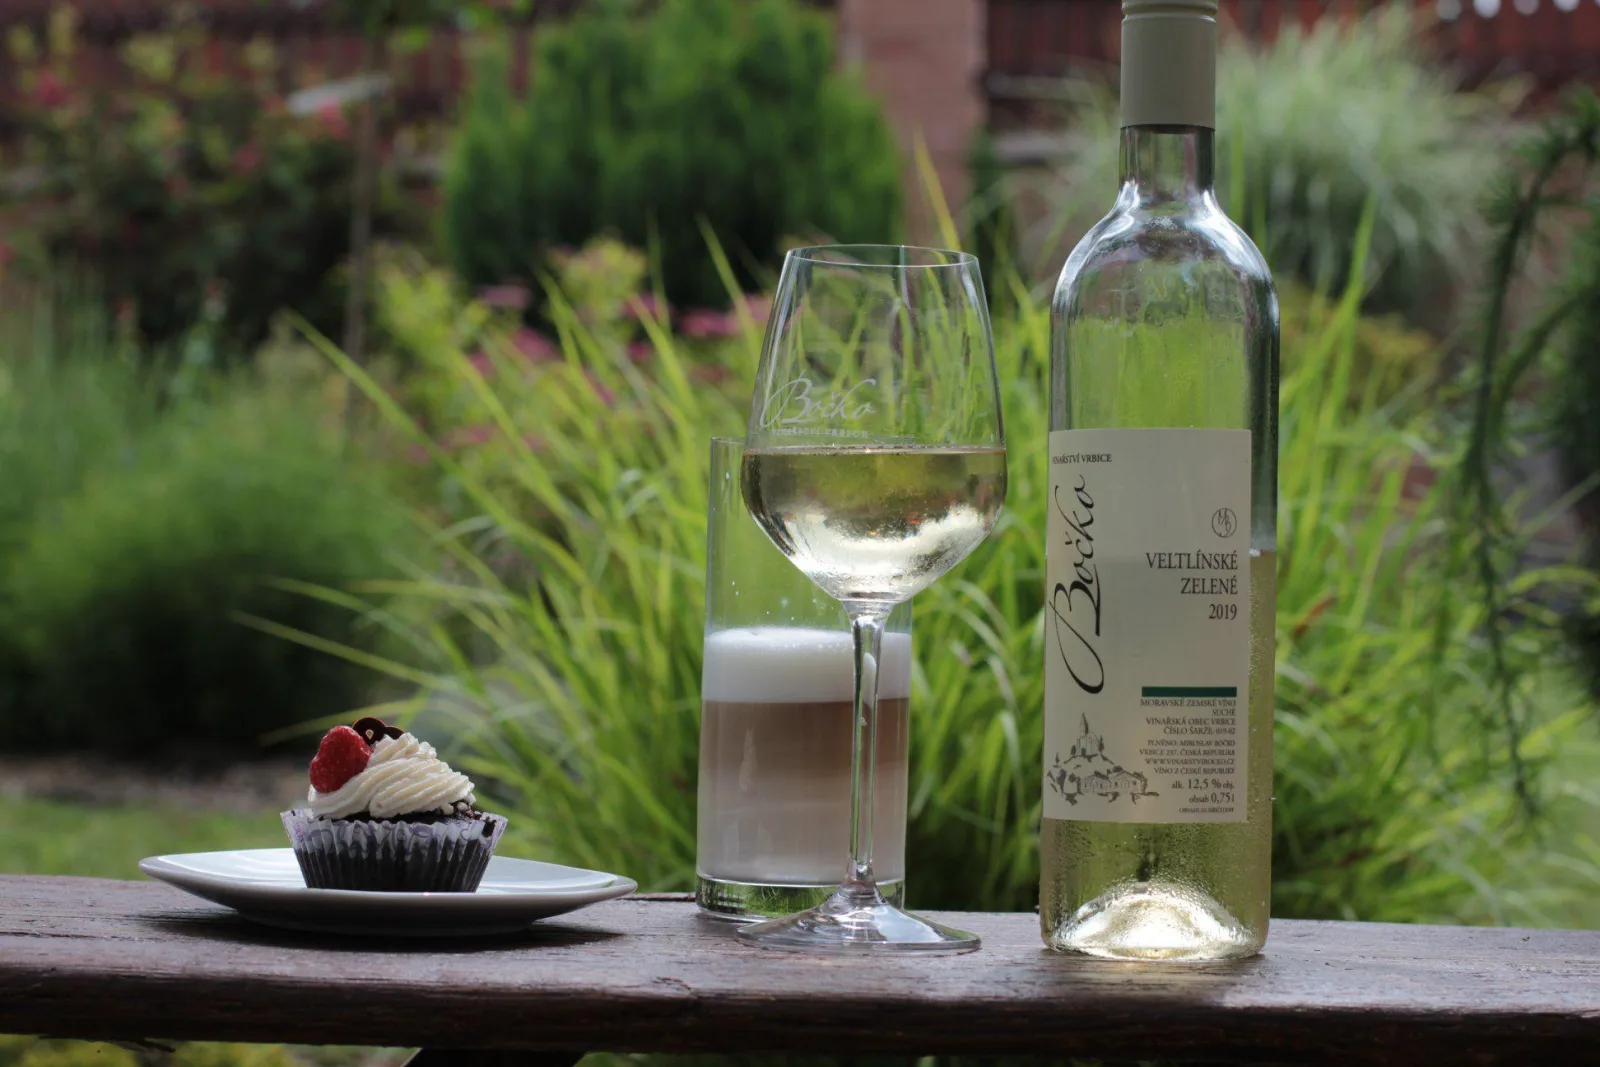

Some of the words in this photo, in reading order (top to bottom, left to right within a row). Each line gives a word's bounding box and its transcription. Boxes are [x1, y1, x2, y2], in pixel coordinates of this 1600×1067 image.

[1081, 454, 1112, 463] VRBICE
[1145, 550, 1238, 569] VELTLÍNSKÉ
[1049, 474, 1104, 694] Bočko
[1181, 576, 1238, 594] ZELENÉ
[1209, 604, 1237, 620] 2019
[1140, 698, 1185, 707] MORAVSKÉ
[1186, 698, 1217, 707] ZEMSKÉ
[1218, 698, 1236, 707] VÍNO
[1212, 708, 1236, 716] SUCHÉ
[1146, 716, 1187, 725] VINAŘSKÁ
[1188, 717, 1210, 725] OBEC
[1211, 717, 1236, 725] VRBICE
[1163, 726, 1188, 735] ČÍSLO
[1179, 739, 1212, 747] MIROSLAV
[1180, 748, 1202, 756] ČESKÁ
[1171, 780, 1184, 789] alk.
[1188, 779, 1209, 790] 12,5
[1211, 778, 1222, 789] %
[1189, 794, 1209, 803] obsah
